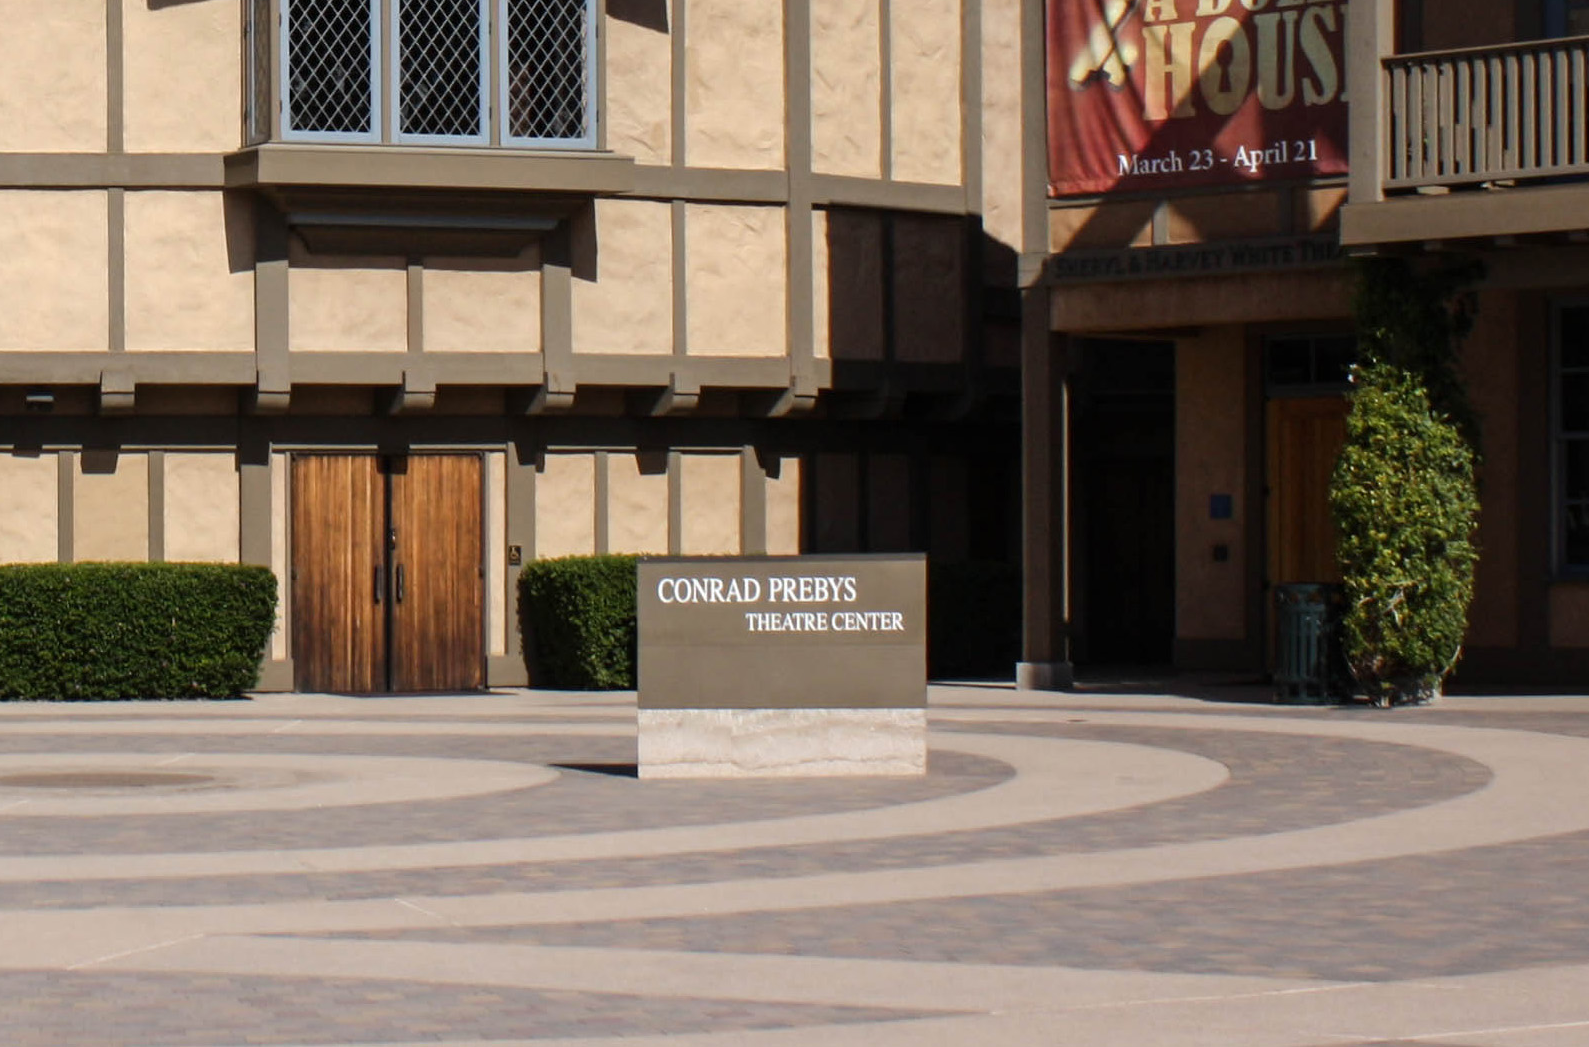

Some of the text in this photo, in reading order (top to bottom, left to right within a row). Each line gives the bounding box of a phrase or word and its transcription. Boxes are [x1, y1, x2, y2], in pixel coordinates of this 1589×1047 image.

[1118, 151, 1183, 177] March
[1188, 150, 1214, 171] 23
[1233, 141, 1287, 173] April
[1293, 139, 1317, 162] 21
[658, 576, 857, 603] CONRAD PREBYS
[745, 611, 904, 631] THEATRE CENTER
